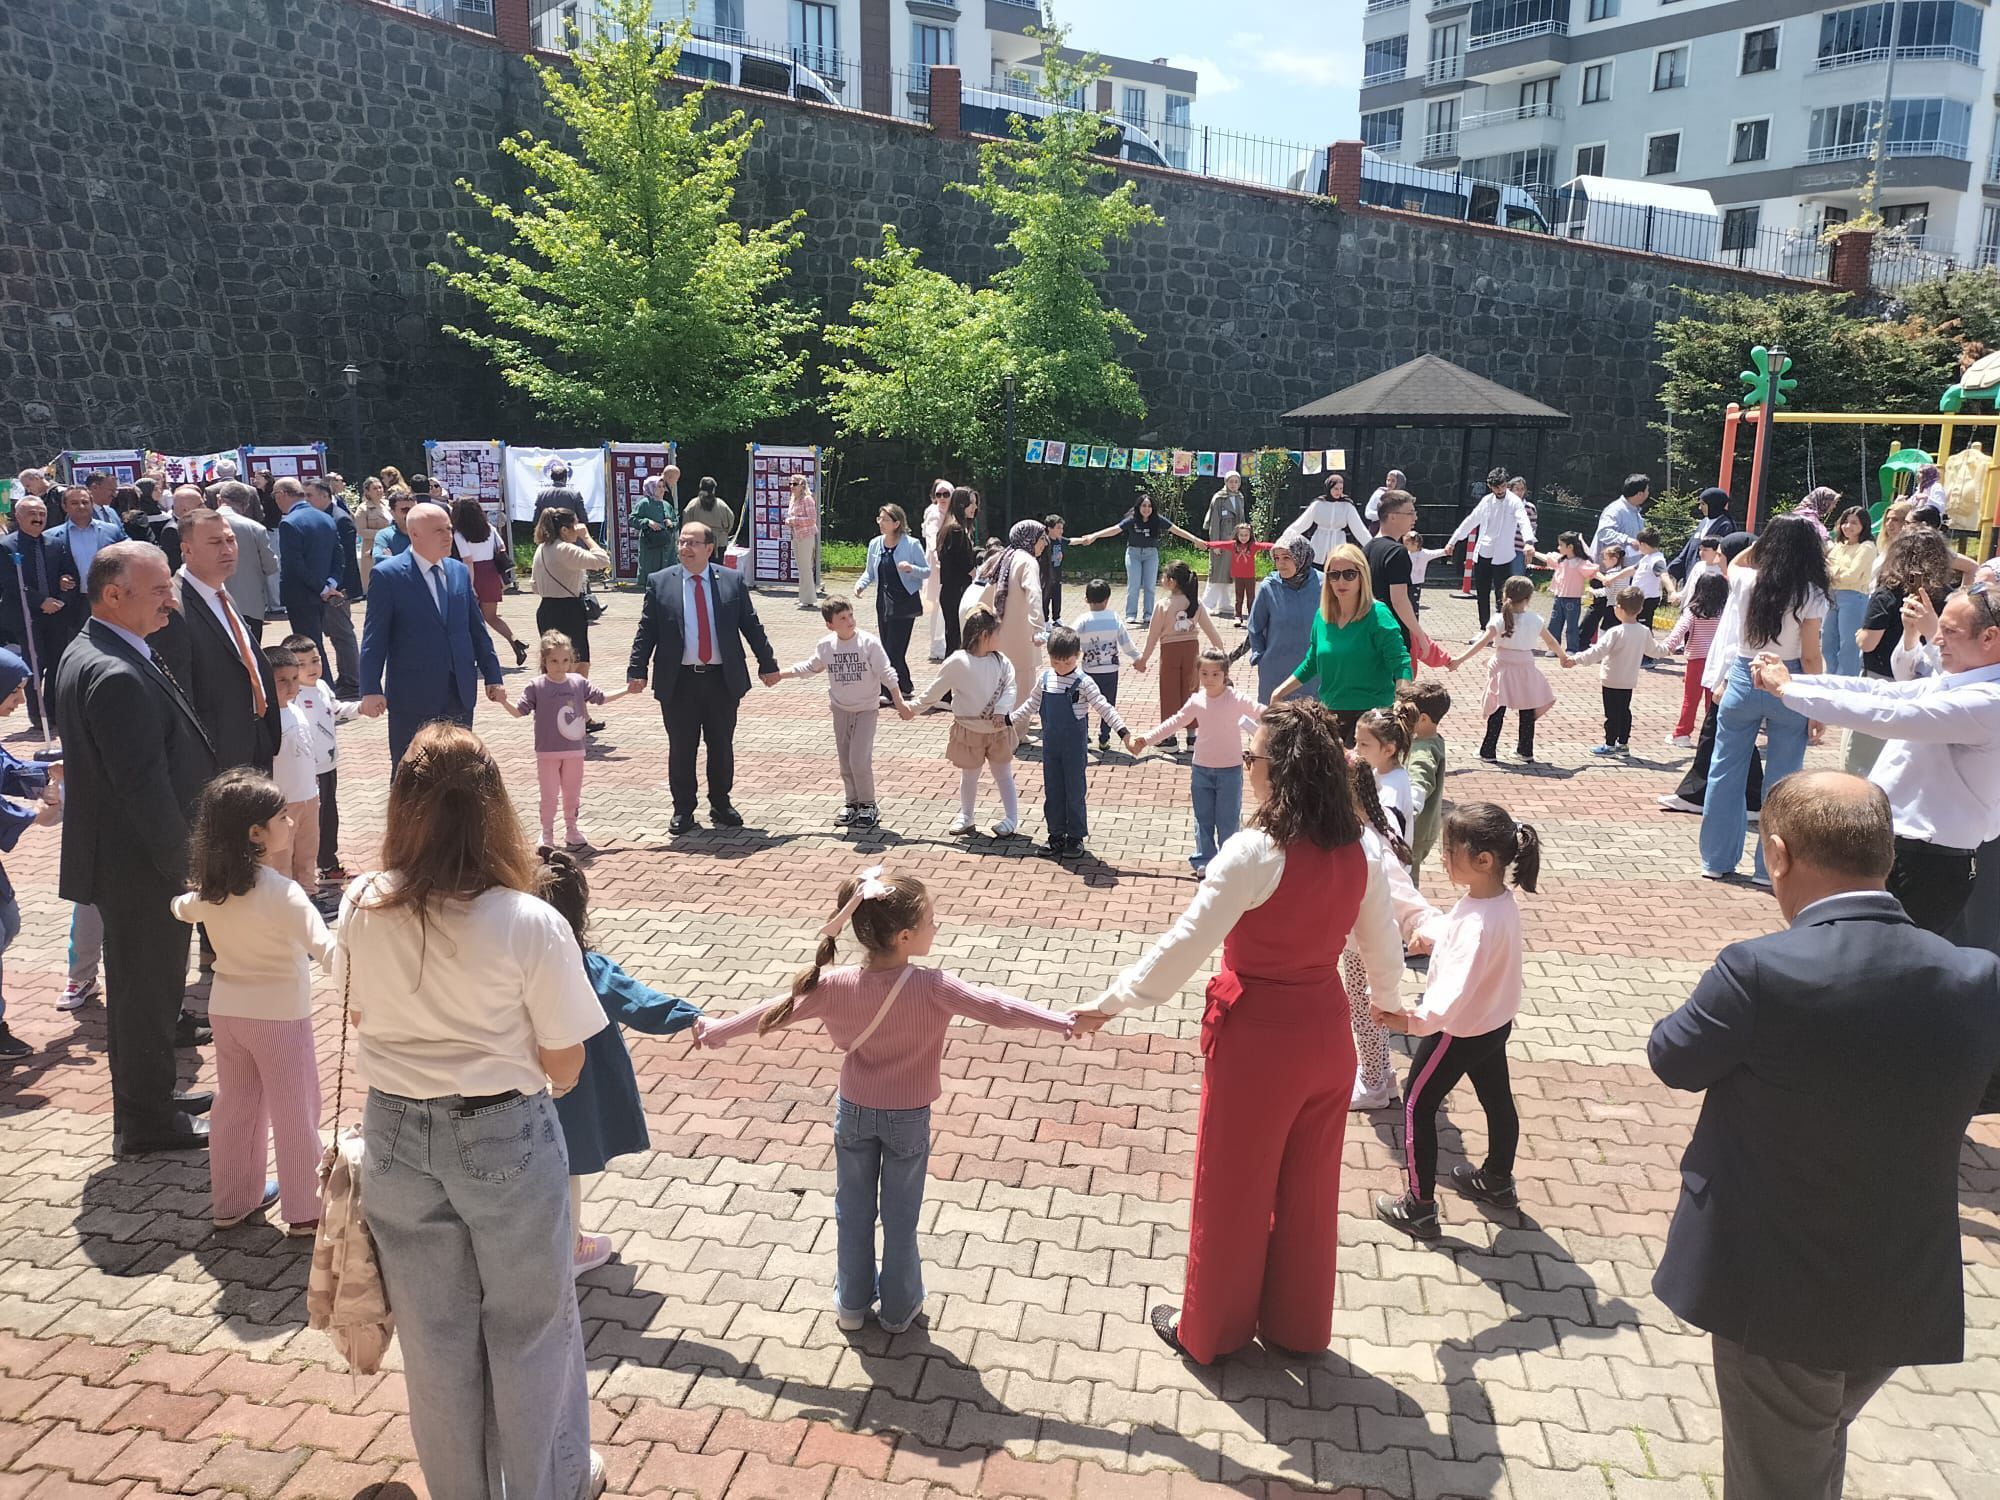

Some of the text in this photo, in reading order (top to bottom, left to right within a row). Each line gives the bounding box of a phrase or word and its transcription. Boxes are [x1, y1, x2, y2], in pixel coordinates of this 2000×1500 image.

[833, 652, 859, 664] TOKYO
[828, 661, 868, 673] NEW YORK
[834, 672, 862, 682] LONDON
